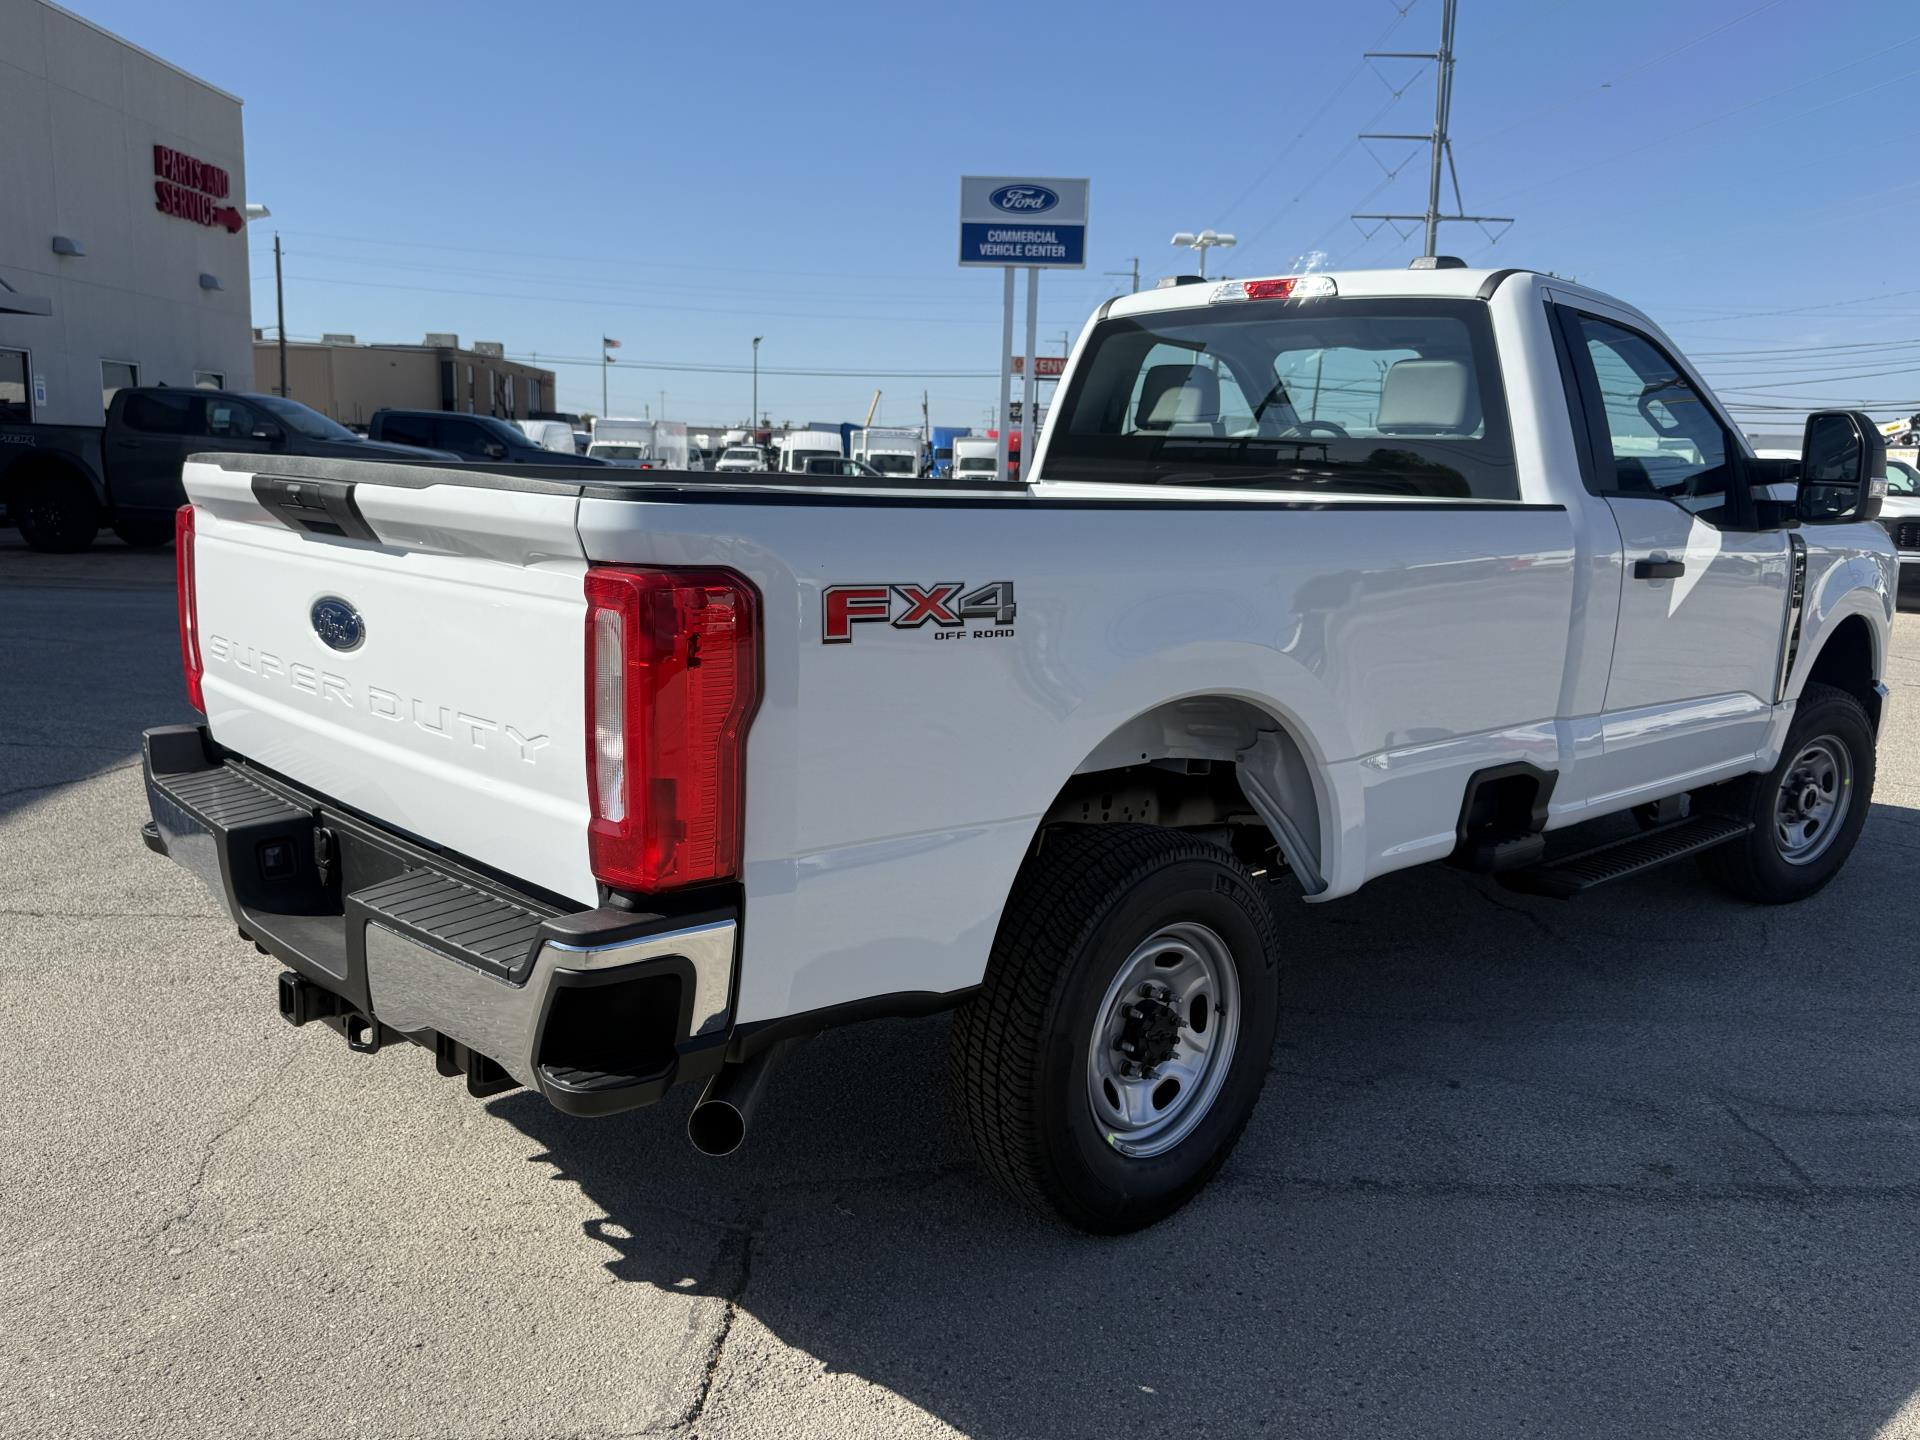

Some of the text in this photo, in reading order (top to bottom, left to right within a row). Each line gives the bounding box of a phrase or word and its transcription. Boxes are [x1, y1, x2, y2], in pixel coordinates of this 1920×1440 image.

[159, 146, 230, 198] PARTS AND
[160, 182, 216, 226] SERVICE
[1002, 189, 1046, 209] Ford
[979, 243, 1065, 257] VEHICLE CENTER
[987, 229, 1059, 243] COMMERCIAL
[319, 607, 348, 640] Ford
[822, 581, 1016, 644] FX4
[934, 629, 1015, 640] OFF ROAD
[208, 634, 551, 766] SUPER DUTY
